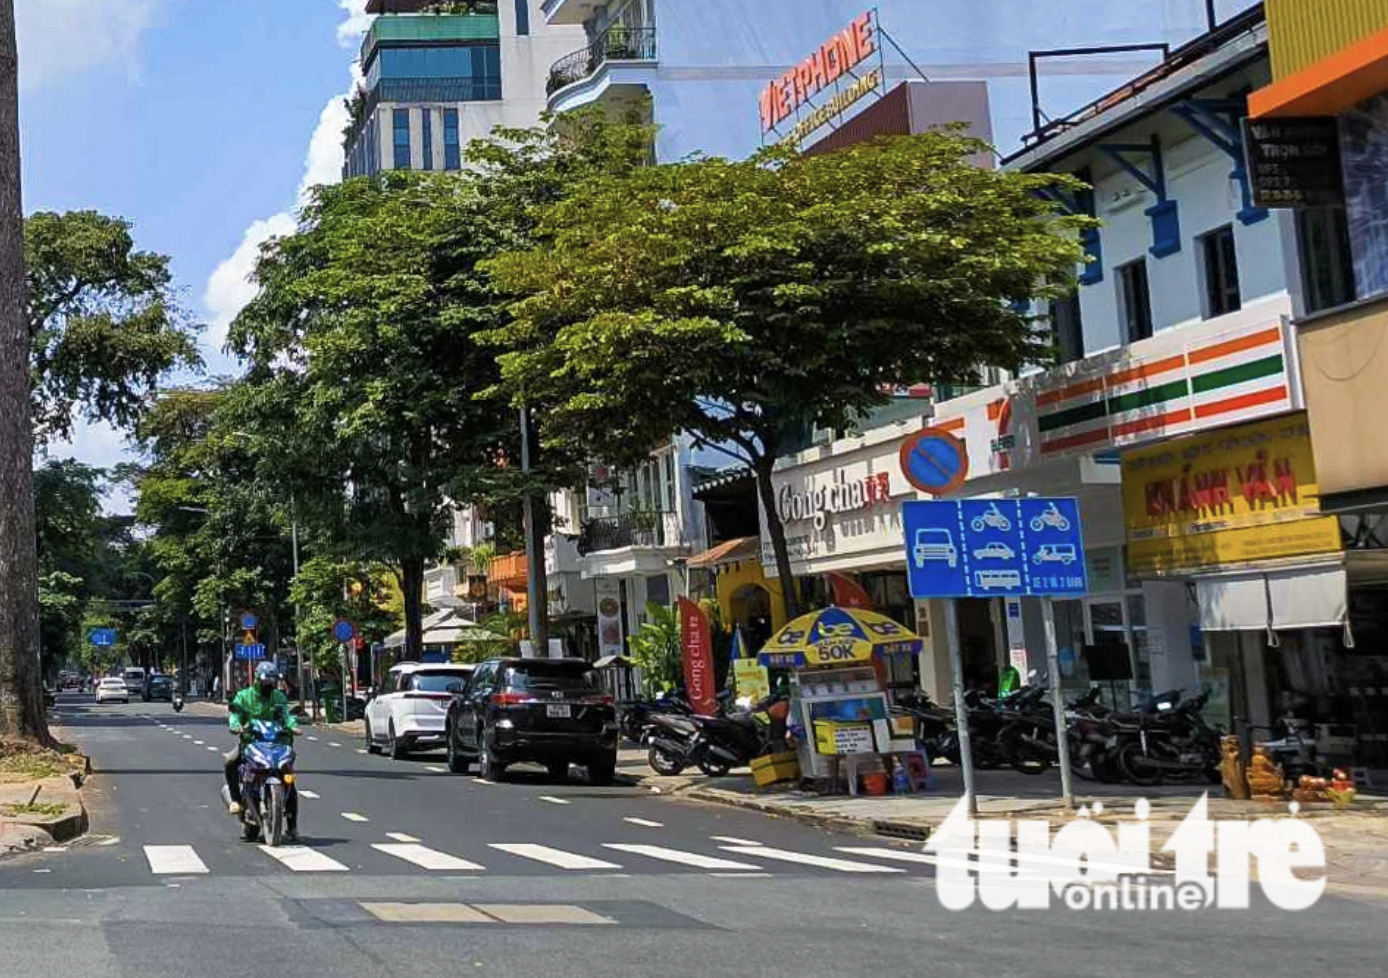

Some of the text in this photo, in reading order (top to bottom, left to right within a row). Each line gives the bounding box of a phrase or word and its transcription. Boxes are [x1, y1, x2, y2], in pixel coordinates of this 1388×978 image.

[759, 10, 876, 131] VIETPHONE
[779, 469, 865, 532] Gong cha
[818, 622, 854, 637] be
[818, 644, 856, 660] 50K
